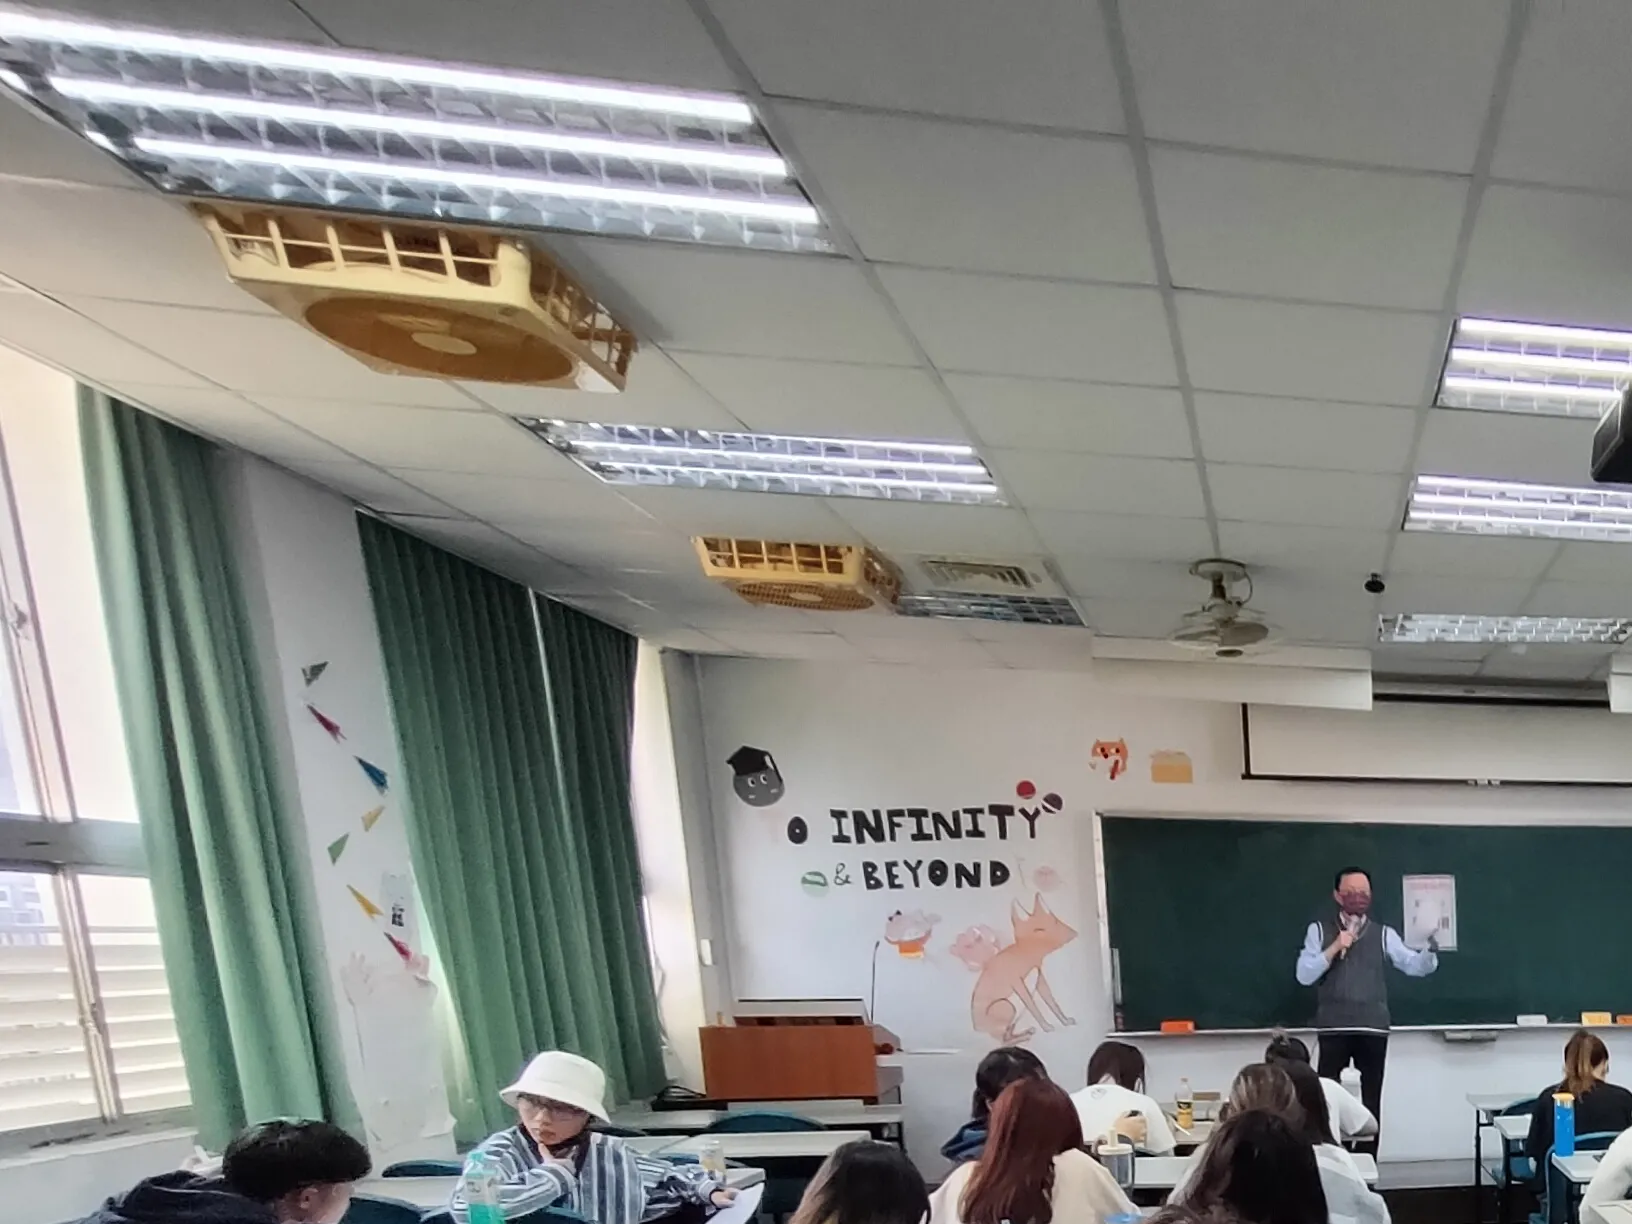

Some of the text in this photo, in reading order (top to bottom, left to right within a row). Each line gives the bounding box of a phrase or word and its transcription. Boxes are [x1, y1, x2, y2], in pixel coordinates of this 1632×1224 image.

[787, 804, 1041, 844] O INFINITY
[834, 859, 1010, 890] & BEYOND
